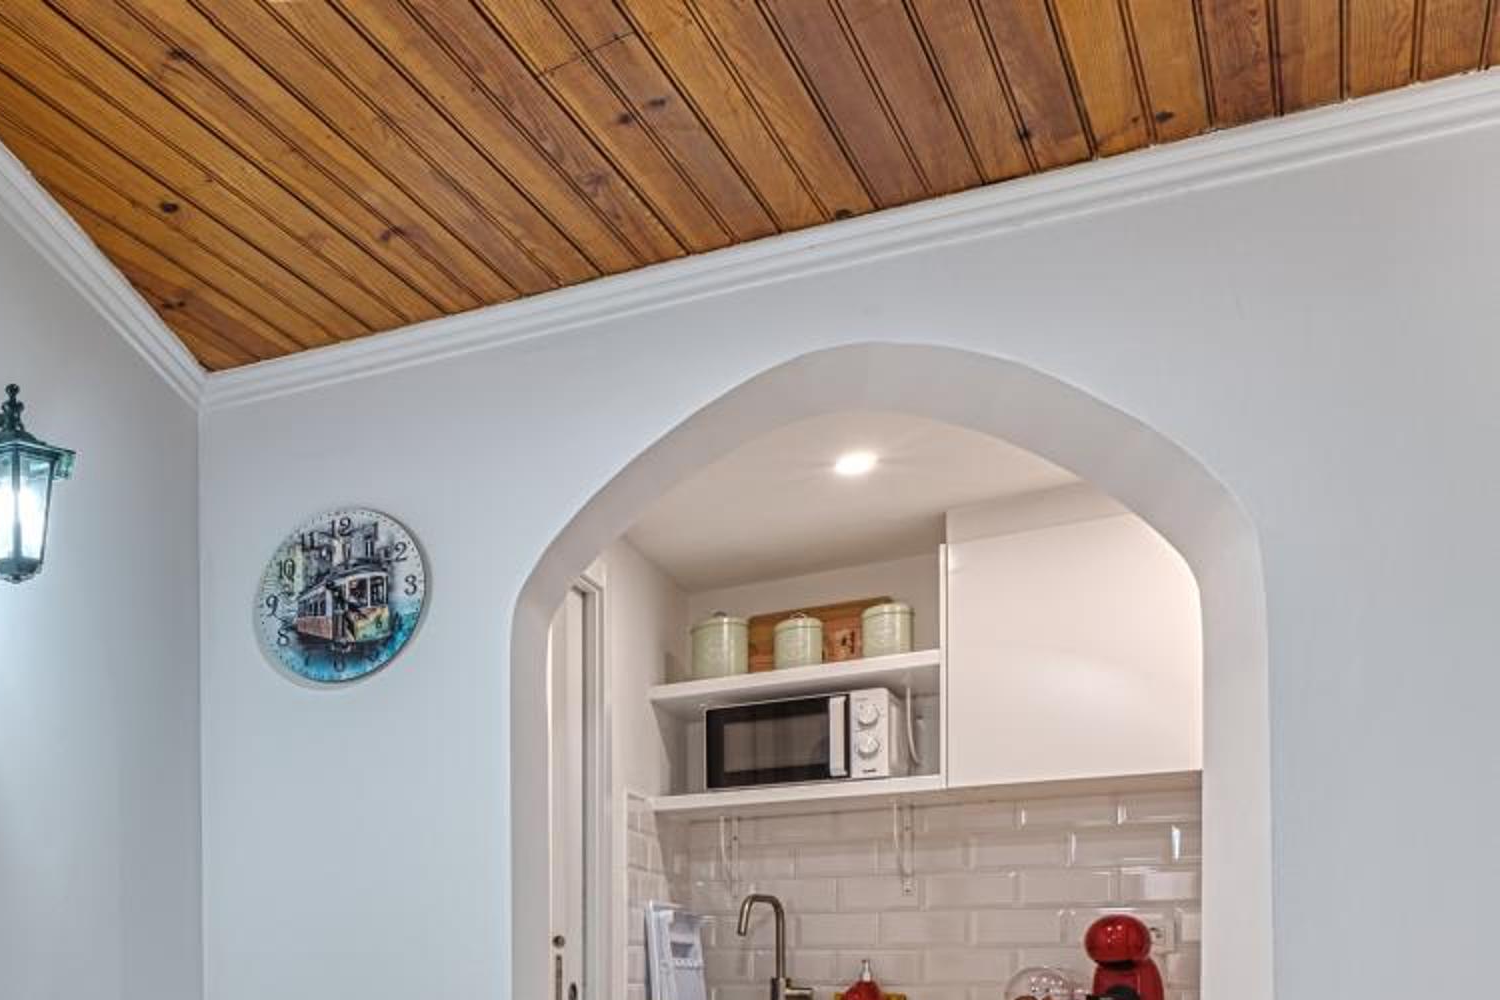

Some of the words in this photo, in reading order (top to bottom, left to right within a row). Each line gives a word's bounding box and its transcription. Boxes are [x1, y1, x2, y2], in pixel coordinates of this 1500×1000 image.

[330, 516, 352, 538] 12
[394, 541, 408, 562] 2
[404, 574, 418, 596] 3
[265, 595, 279, 618] 9
